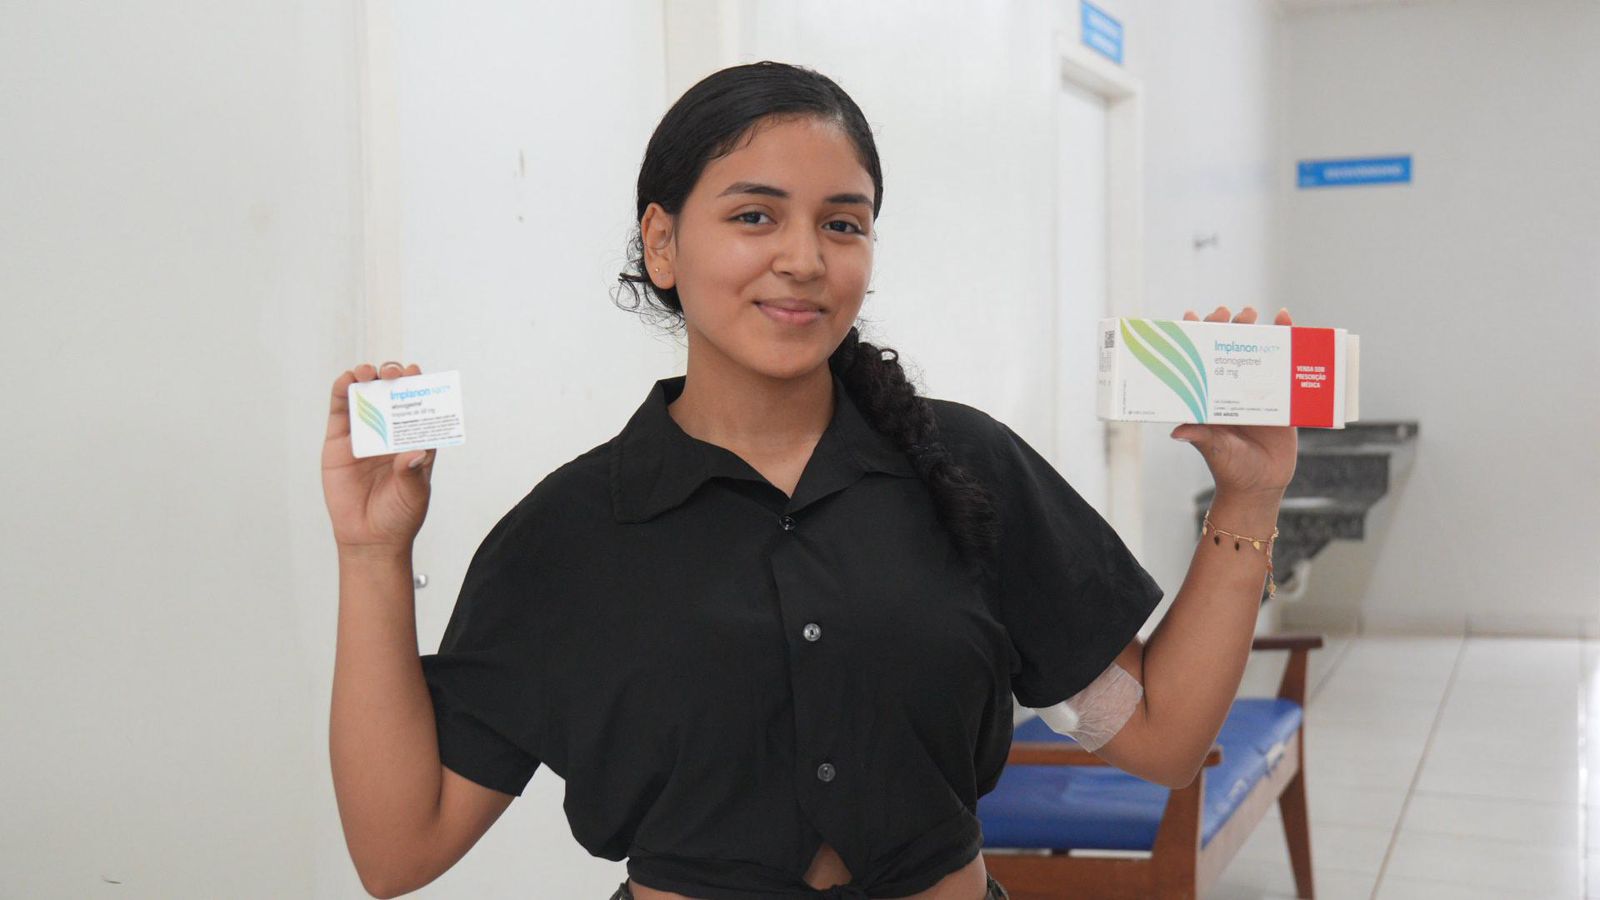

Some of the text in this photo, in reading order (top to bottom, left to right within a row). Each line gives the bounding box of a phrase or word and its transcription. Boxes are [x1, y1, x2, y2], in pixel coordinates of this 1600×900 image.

[1214, 340, 1258, 354] Implanon
[1214, 357, 1262, 367] etonogestrel
[1214, 367, 1239, 379] 68 mg
[1296, 365, 1314, 373] VENDA
[1295, 373, 1327, 381] PRESCRIÇÃO
[1300, 381, 1321, 389] MÉDICA
[390, 387, 431, 401] Implanon
